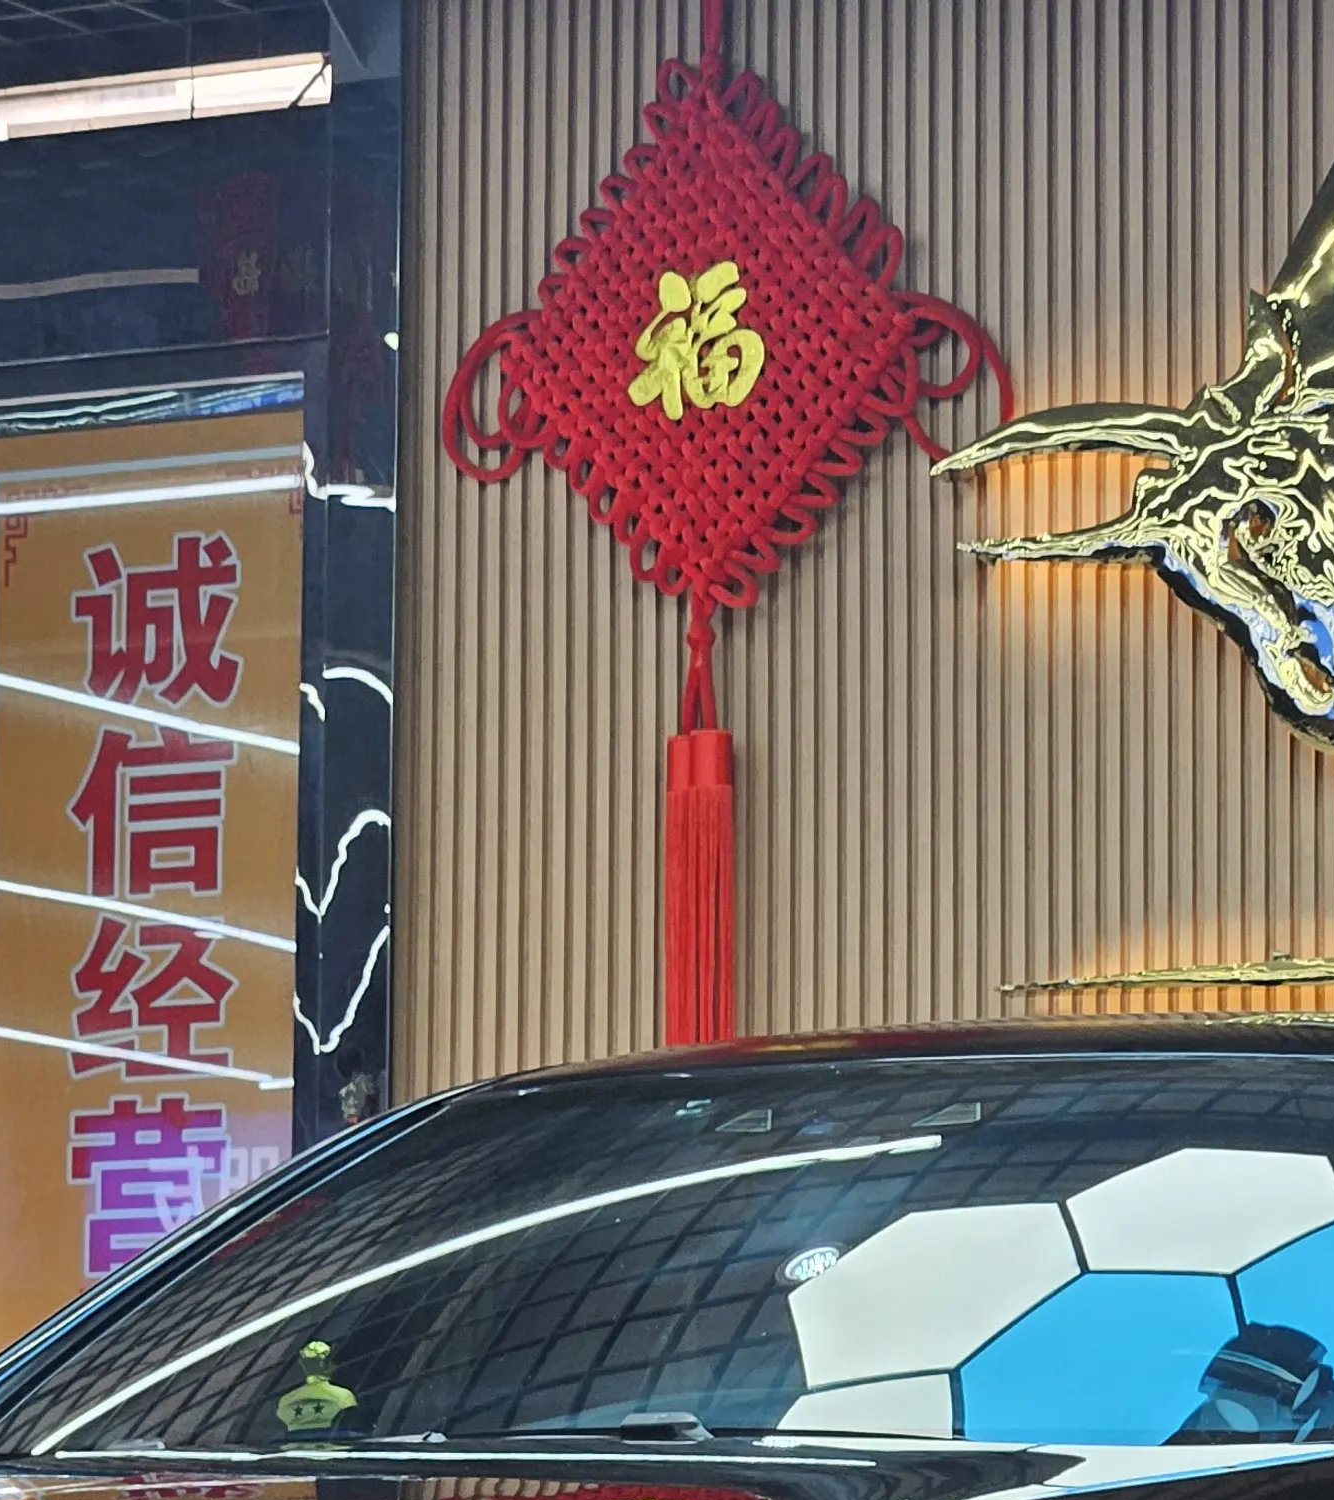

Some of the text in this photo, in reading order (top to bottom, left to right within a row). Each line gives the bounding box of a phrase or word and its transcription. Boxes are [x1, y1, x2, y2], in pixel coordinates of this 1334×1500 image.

[627, 261, 765, 420] 福
[67, 528, 245, 1280] 诚信经营
